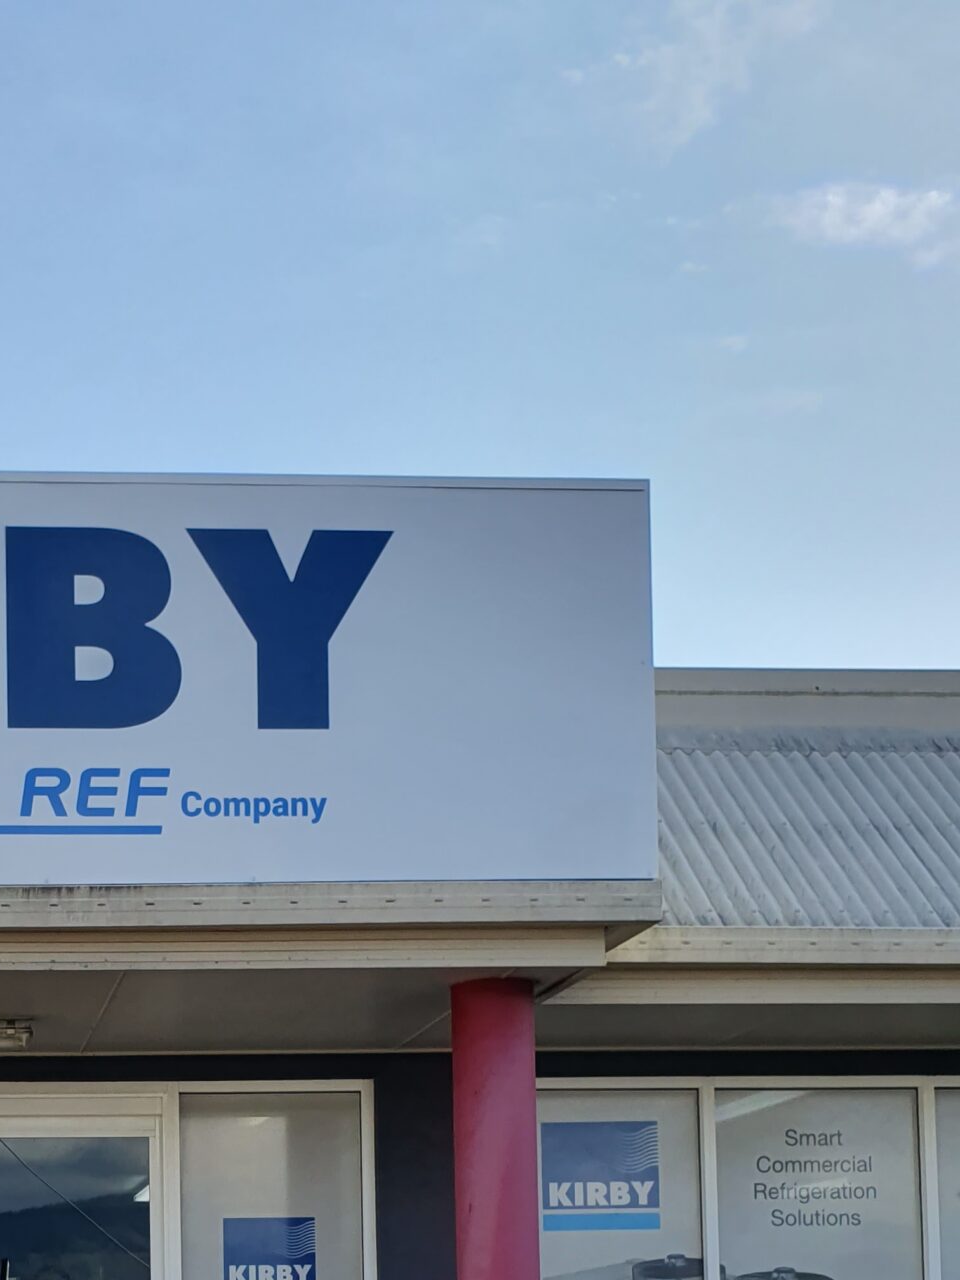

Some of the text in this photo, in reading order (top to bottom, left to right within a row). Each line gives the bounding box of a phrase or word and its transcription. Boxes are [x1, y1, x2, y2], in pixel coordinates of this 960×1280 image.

[19, 767, 171, 818] REF
[180, 792, 327, 824] Company
[785, 1128, 843, 1147] Smart
[756, 1155, 873, 1174] Commercial
[548, 1181, 655, 1207] KIRBY
[753, 1182, 878, 1204] Refrigeration
[771, 1208, 862, 1227] Solutions
